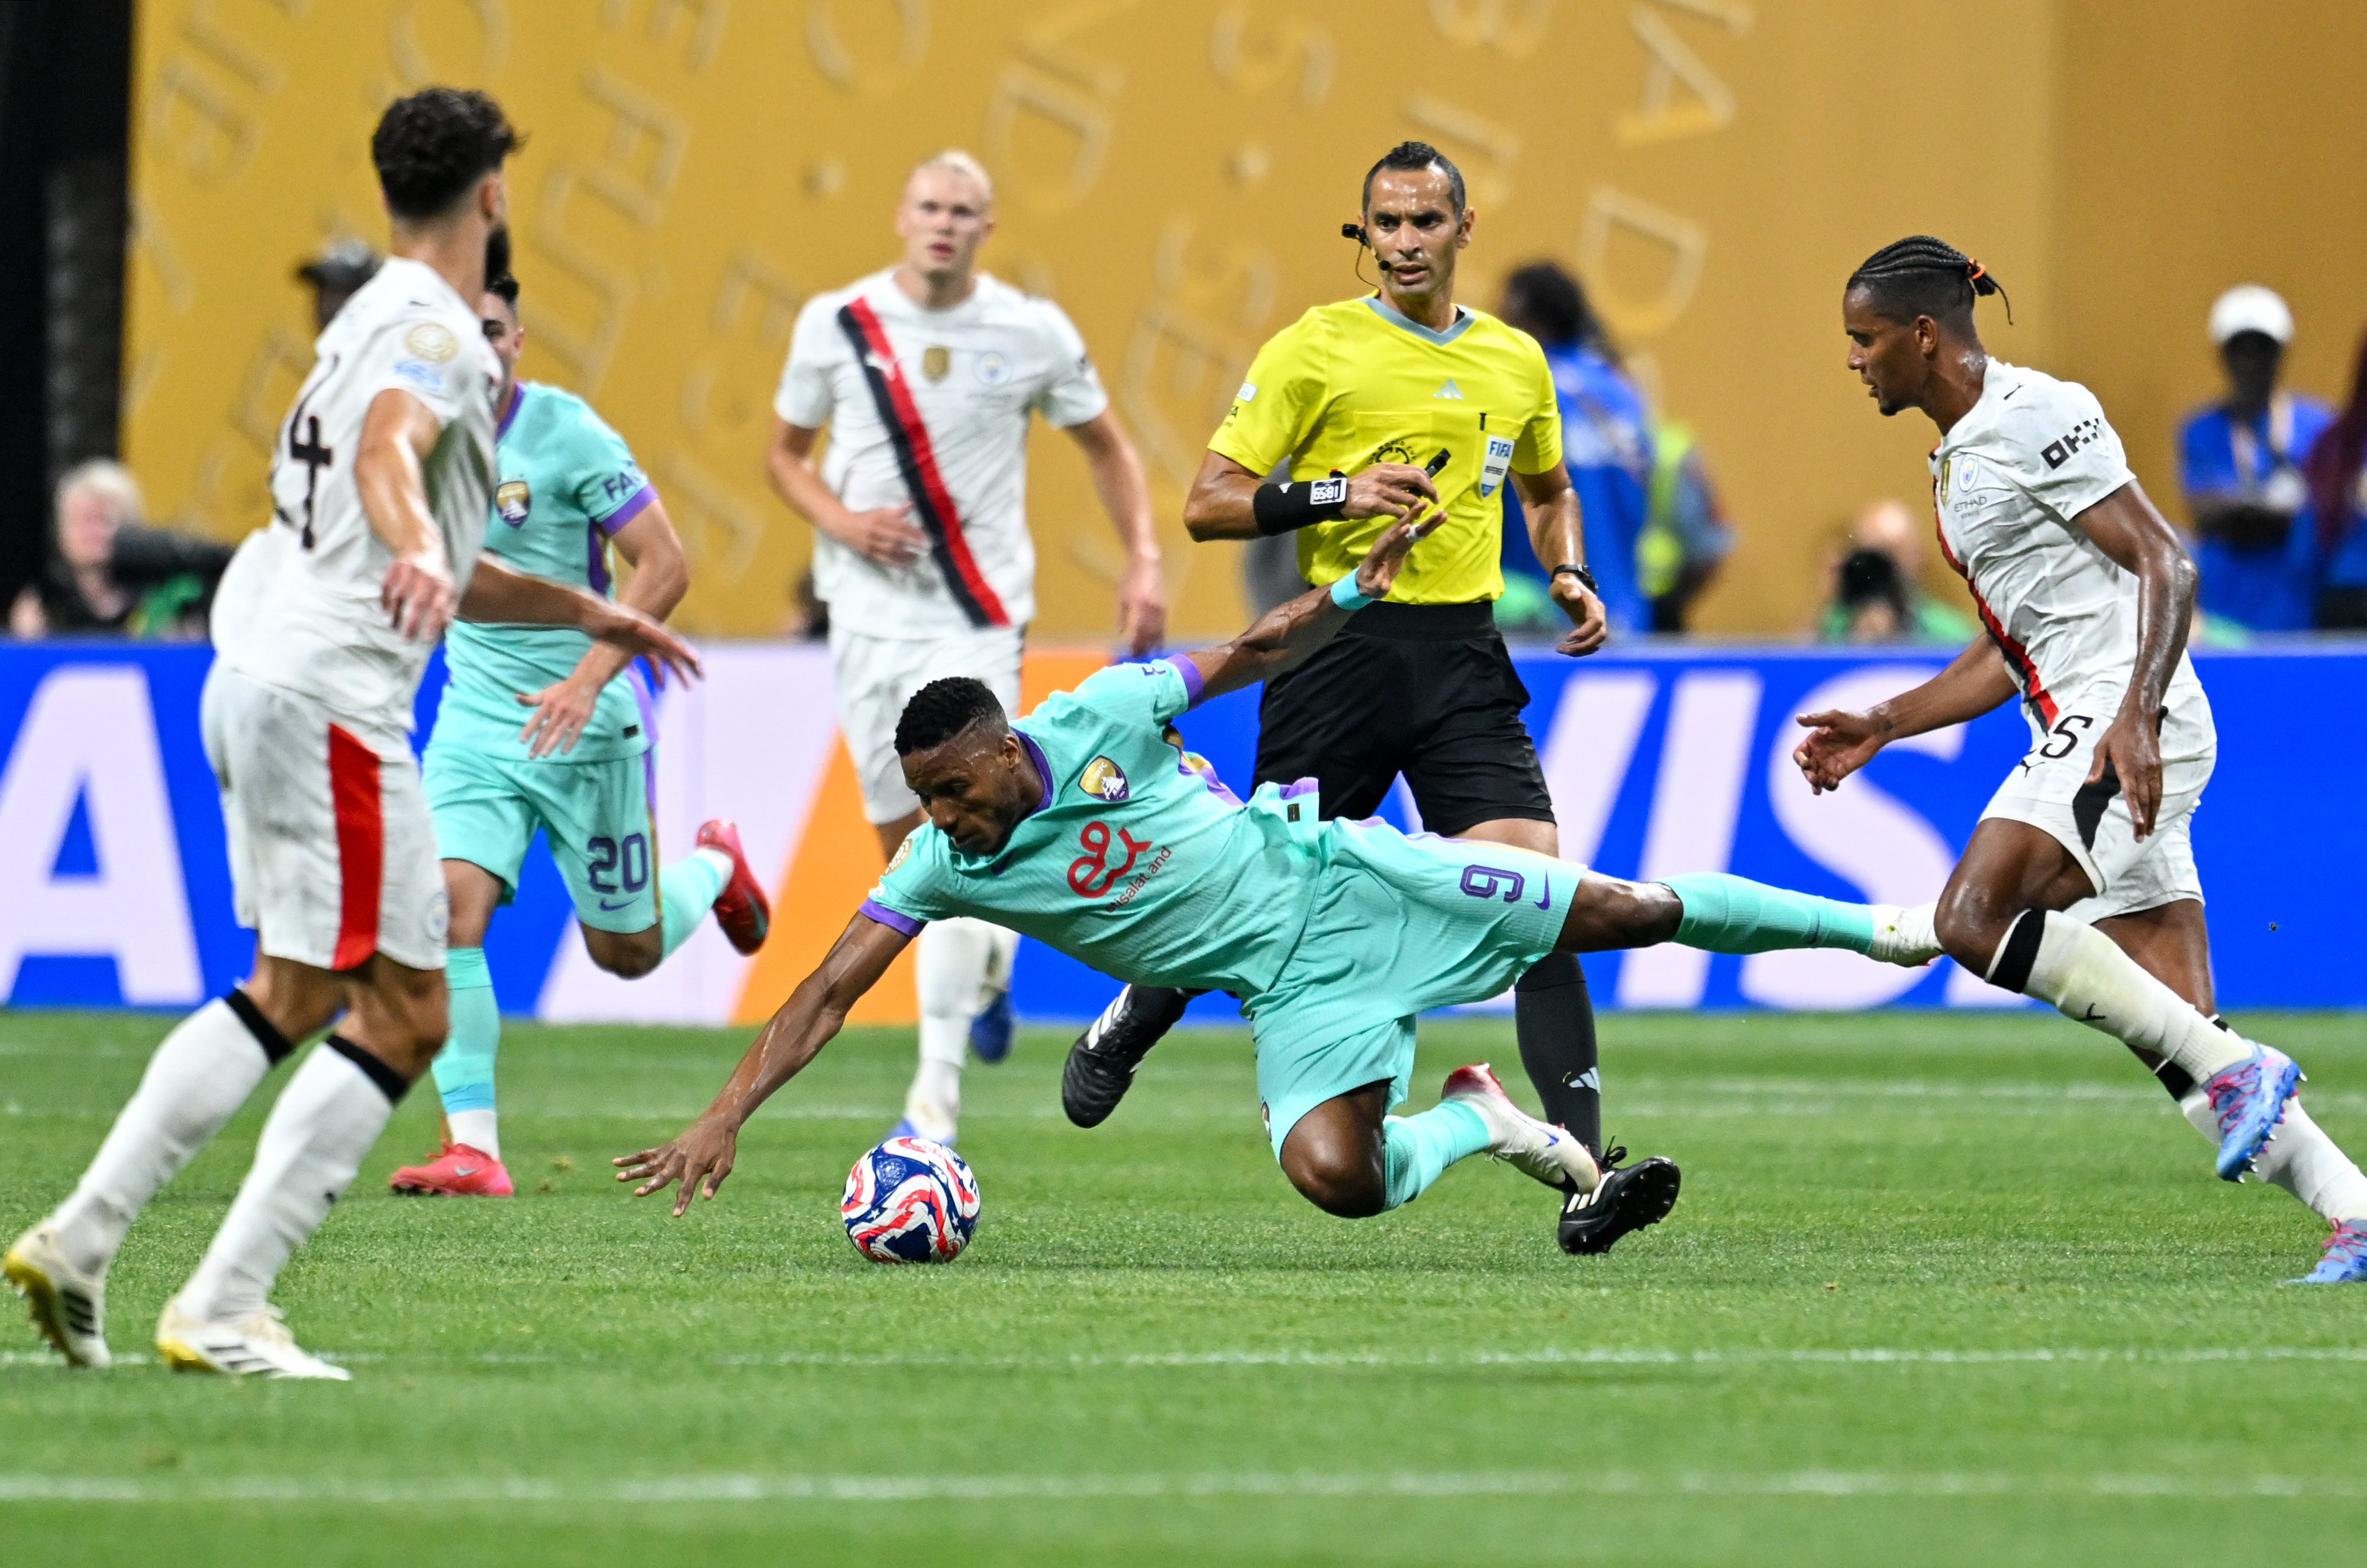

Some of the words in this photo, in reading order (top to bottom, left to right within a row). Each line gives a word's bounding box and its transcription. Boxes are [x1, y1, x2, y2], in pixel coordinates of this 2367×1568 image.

[275, 353, 340, 550] 4
[1488, 440, 1513, 459] FIFA
[2029, 715, 2094, 759] 5
[588, 832, 649, 895] 20
[1148, 844, 1172, 875] and
[1459, 864, 1526, 904] 9
